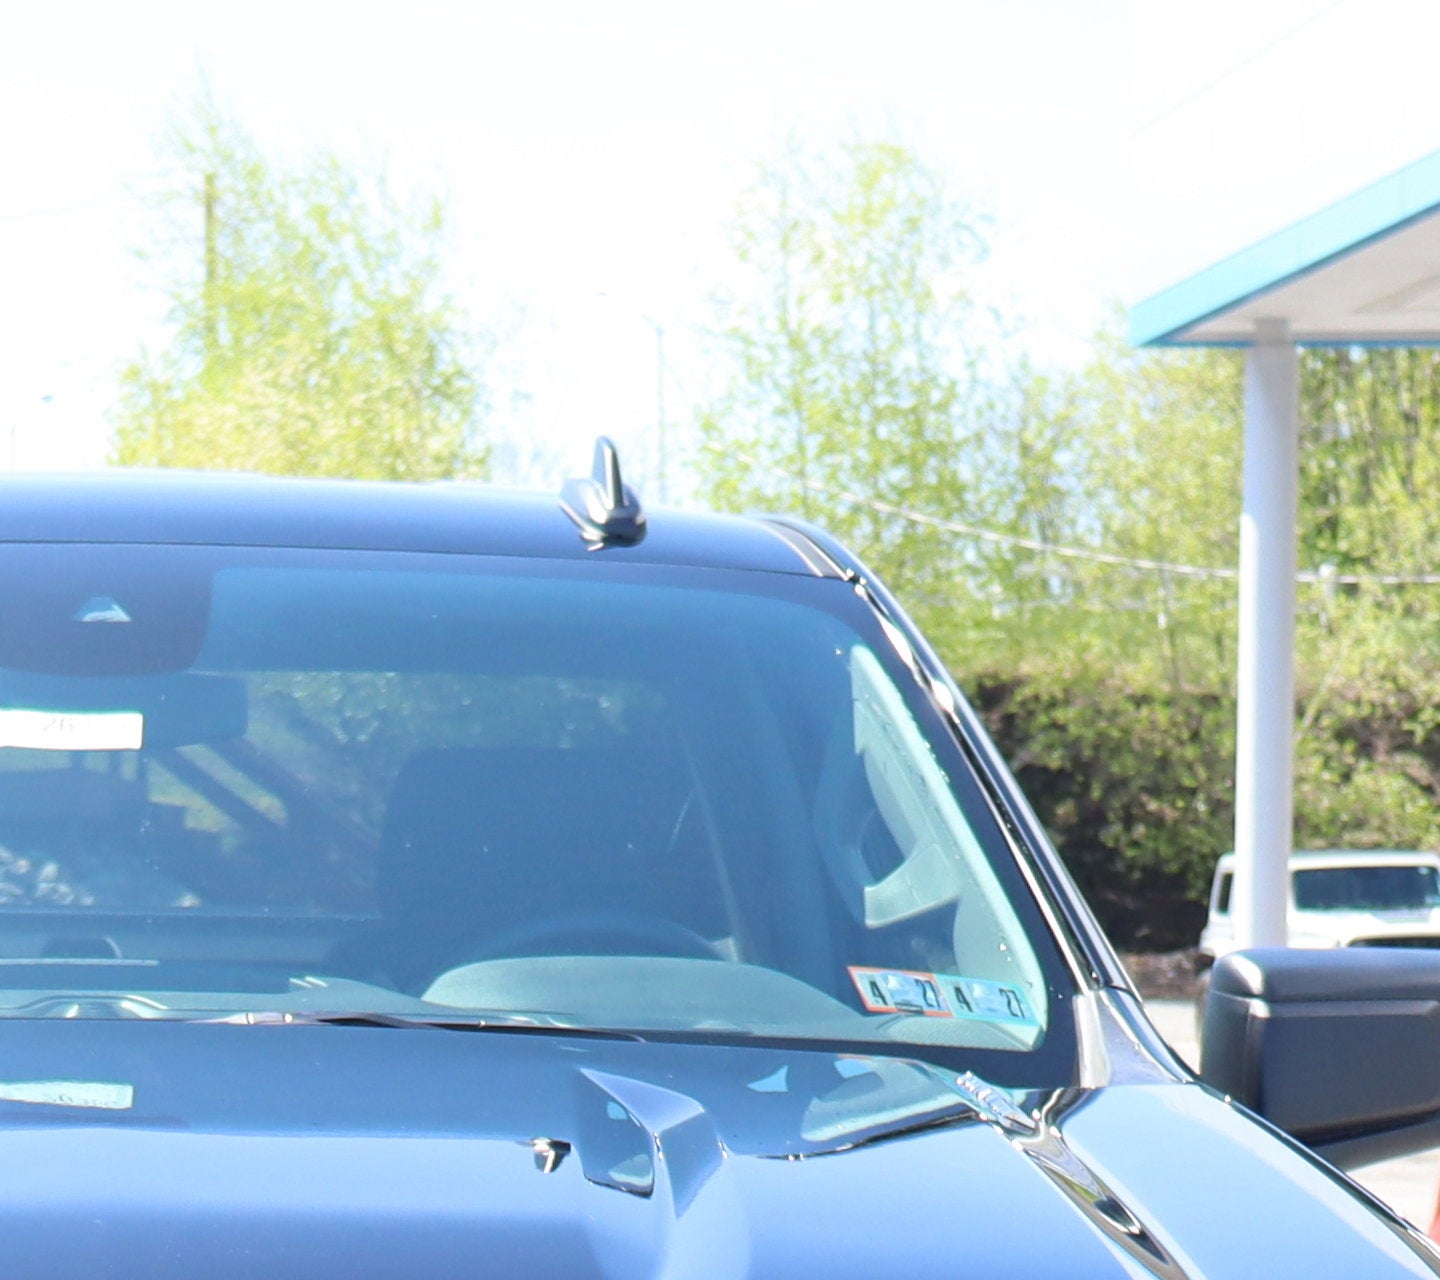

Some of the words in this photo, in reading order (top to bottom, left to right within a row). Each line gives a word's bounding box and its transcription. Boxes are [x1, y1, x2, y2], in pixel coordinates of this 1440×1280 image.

[870, 980, 889, 1006] 4
[914, 978, 941, 1009] 27
[954, 986, 974, 1013] 4
[998, 988, 1026, 1019] 27
